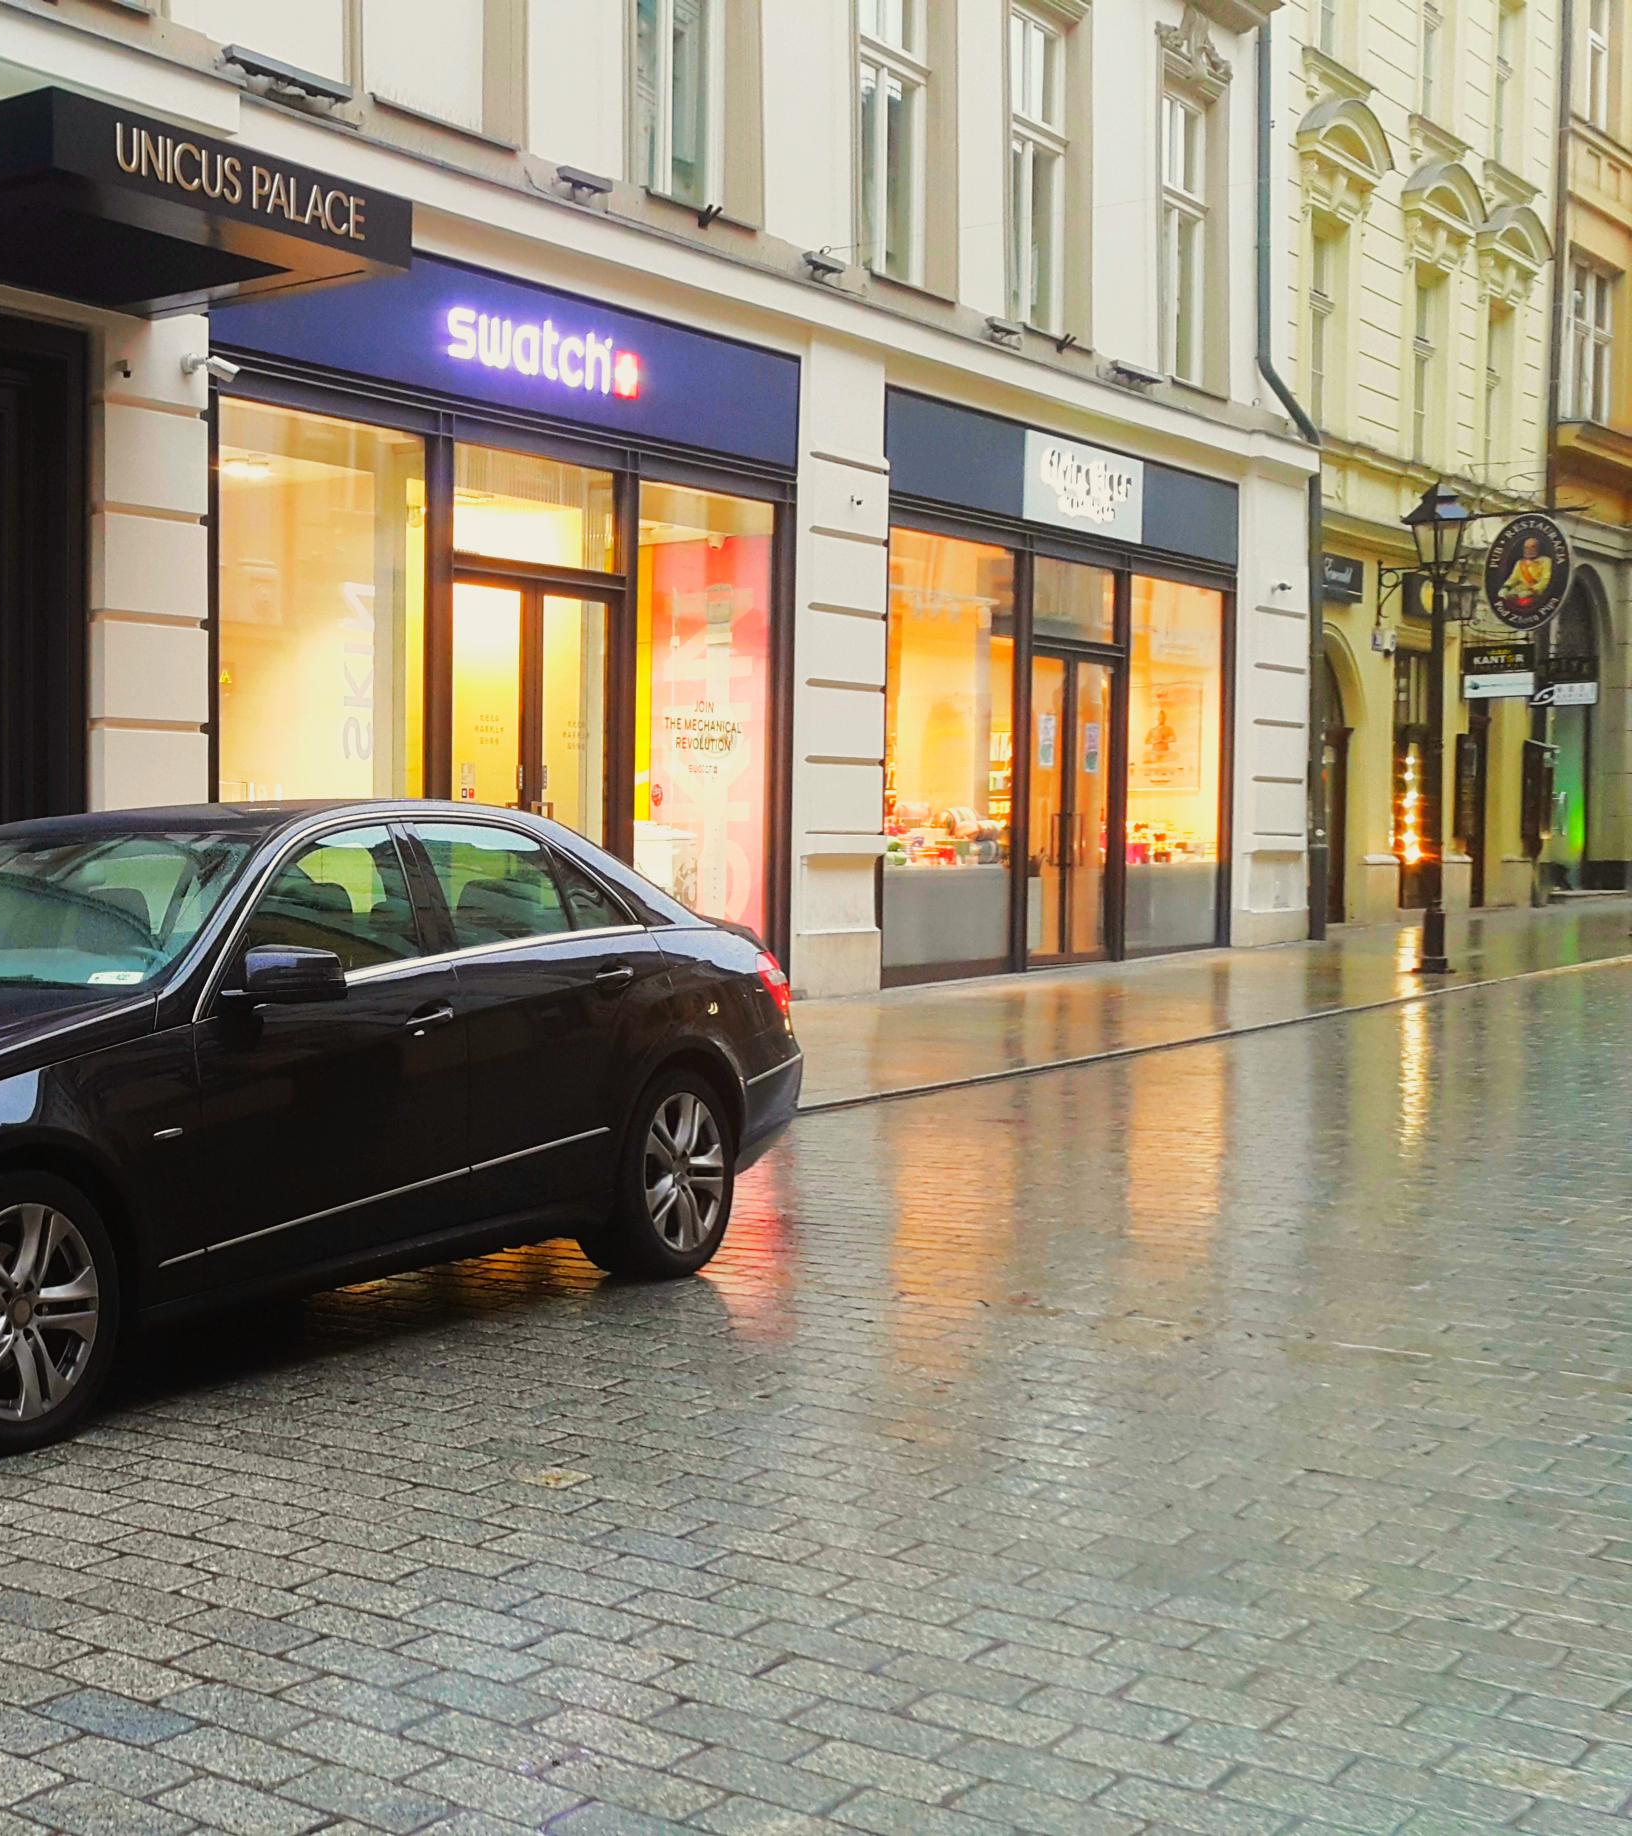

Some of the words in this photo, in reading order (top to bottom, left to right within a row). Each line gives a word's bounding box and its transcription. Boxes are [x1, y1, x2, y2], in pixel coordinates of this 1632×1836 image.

[116, 122, 243, 204] UNICUS
[252, 165, 366, 241] PALACE
[447, 306, 612, 396] swatch
[694, 700, 714, 713] JOIN
[664, 716, 681, 730] THE
[684, 718, 742, 734] MECHANICAL
[676, 736, 732, 752] REVOLUTION
